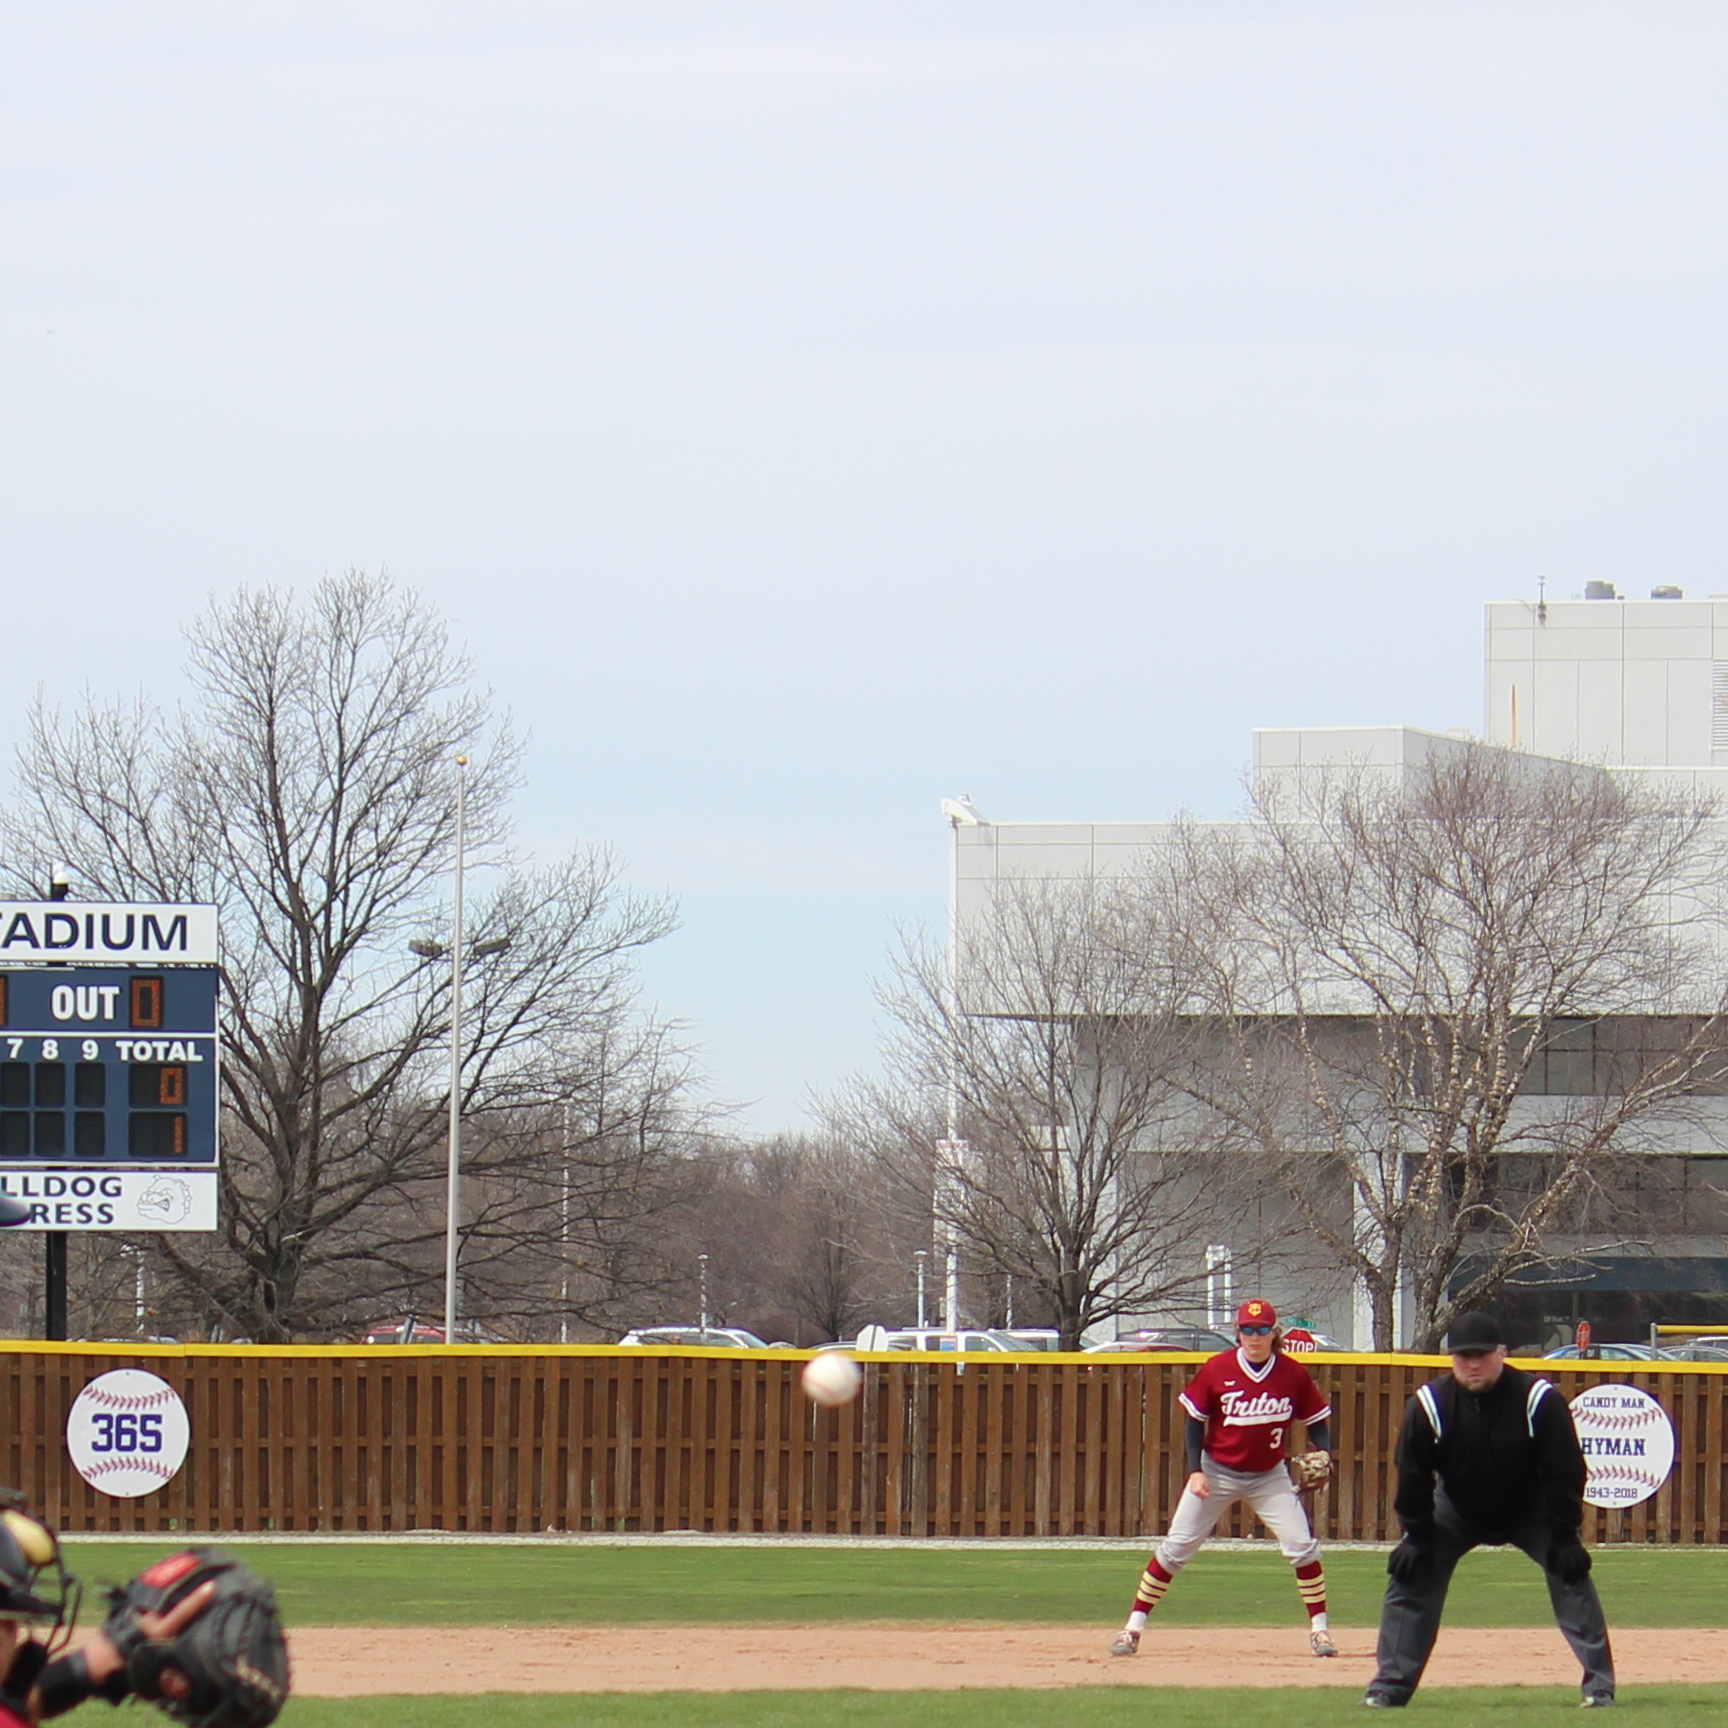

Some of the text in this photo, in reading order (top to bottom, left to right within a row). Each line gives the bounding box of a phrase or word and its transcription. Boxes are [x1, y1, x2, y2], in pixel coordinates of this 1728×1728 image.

[51, 985, 120, 1020] OUT
[7, 1039, 23, 1059] 7
[42, 1039, 59, 1060] 8
[82, 1040, 99, 1061] 9
[116, 1041, 203, 1061] TOTAL
[1282, 1338, 1314, 1353] STOP
[1220, 1390, 1293, 1421] Triton
[1582, 1397, 1645, 1408] CANDY MAN
[91, 1413, 162, 1452] 365
[1269, 1428, 1283, 1449] 3
[1581, 1437, 1646, 1456] HYMAN
[1586, 1487, 1638, 1499] 1943-2018
